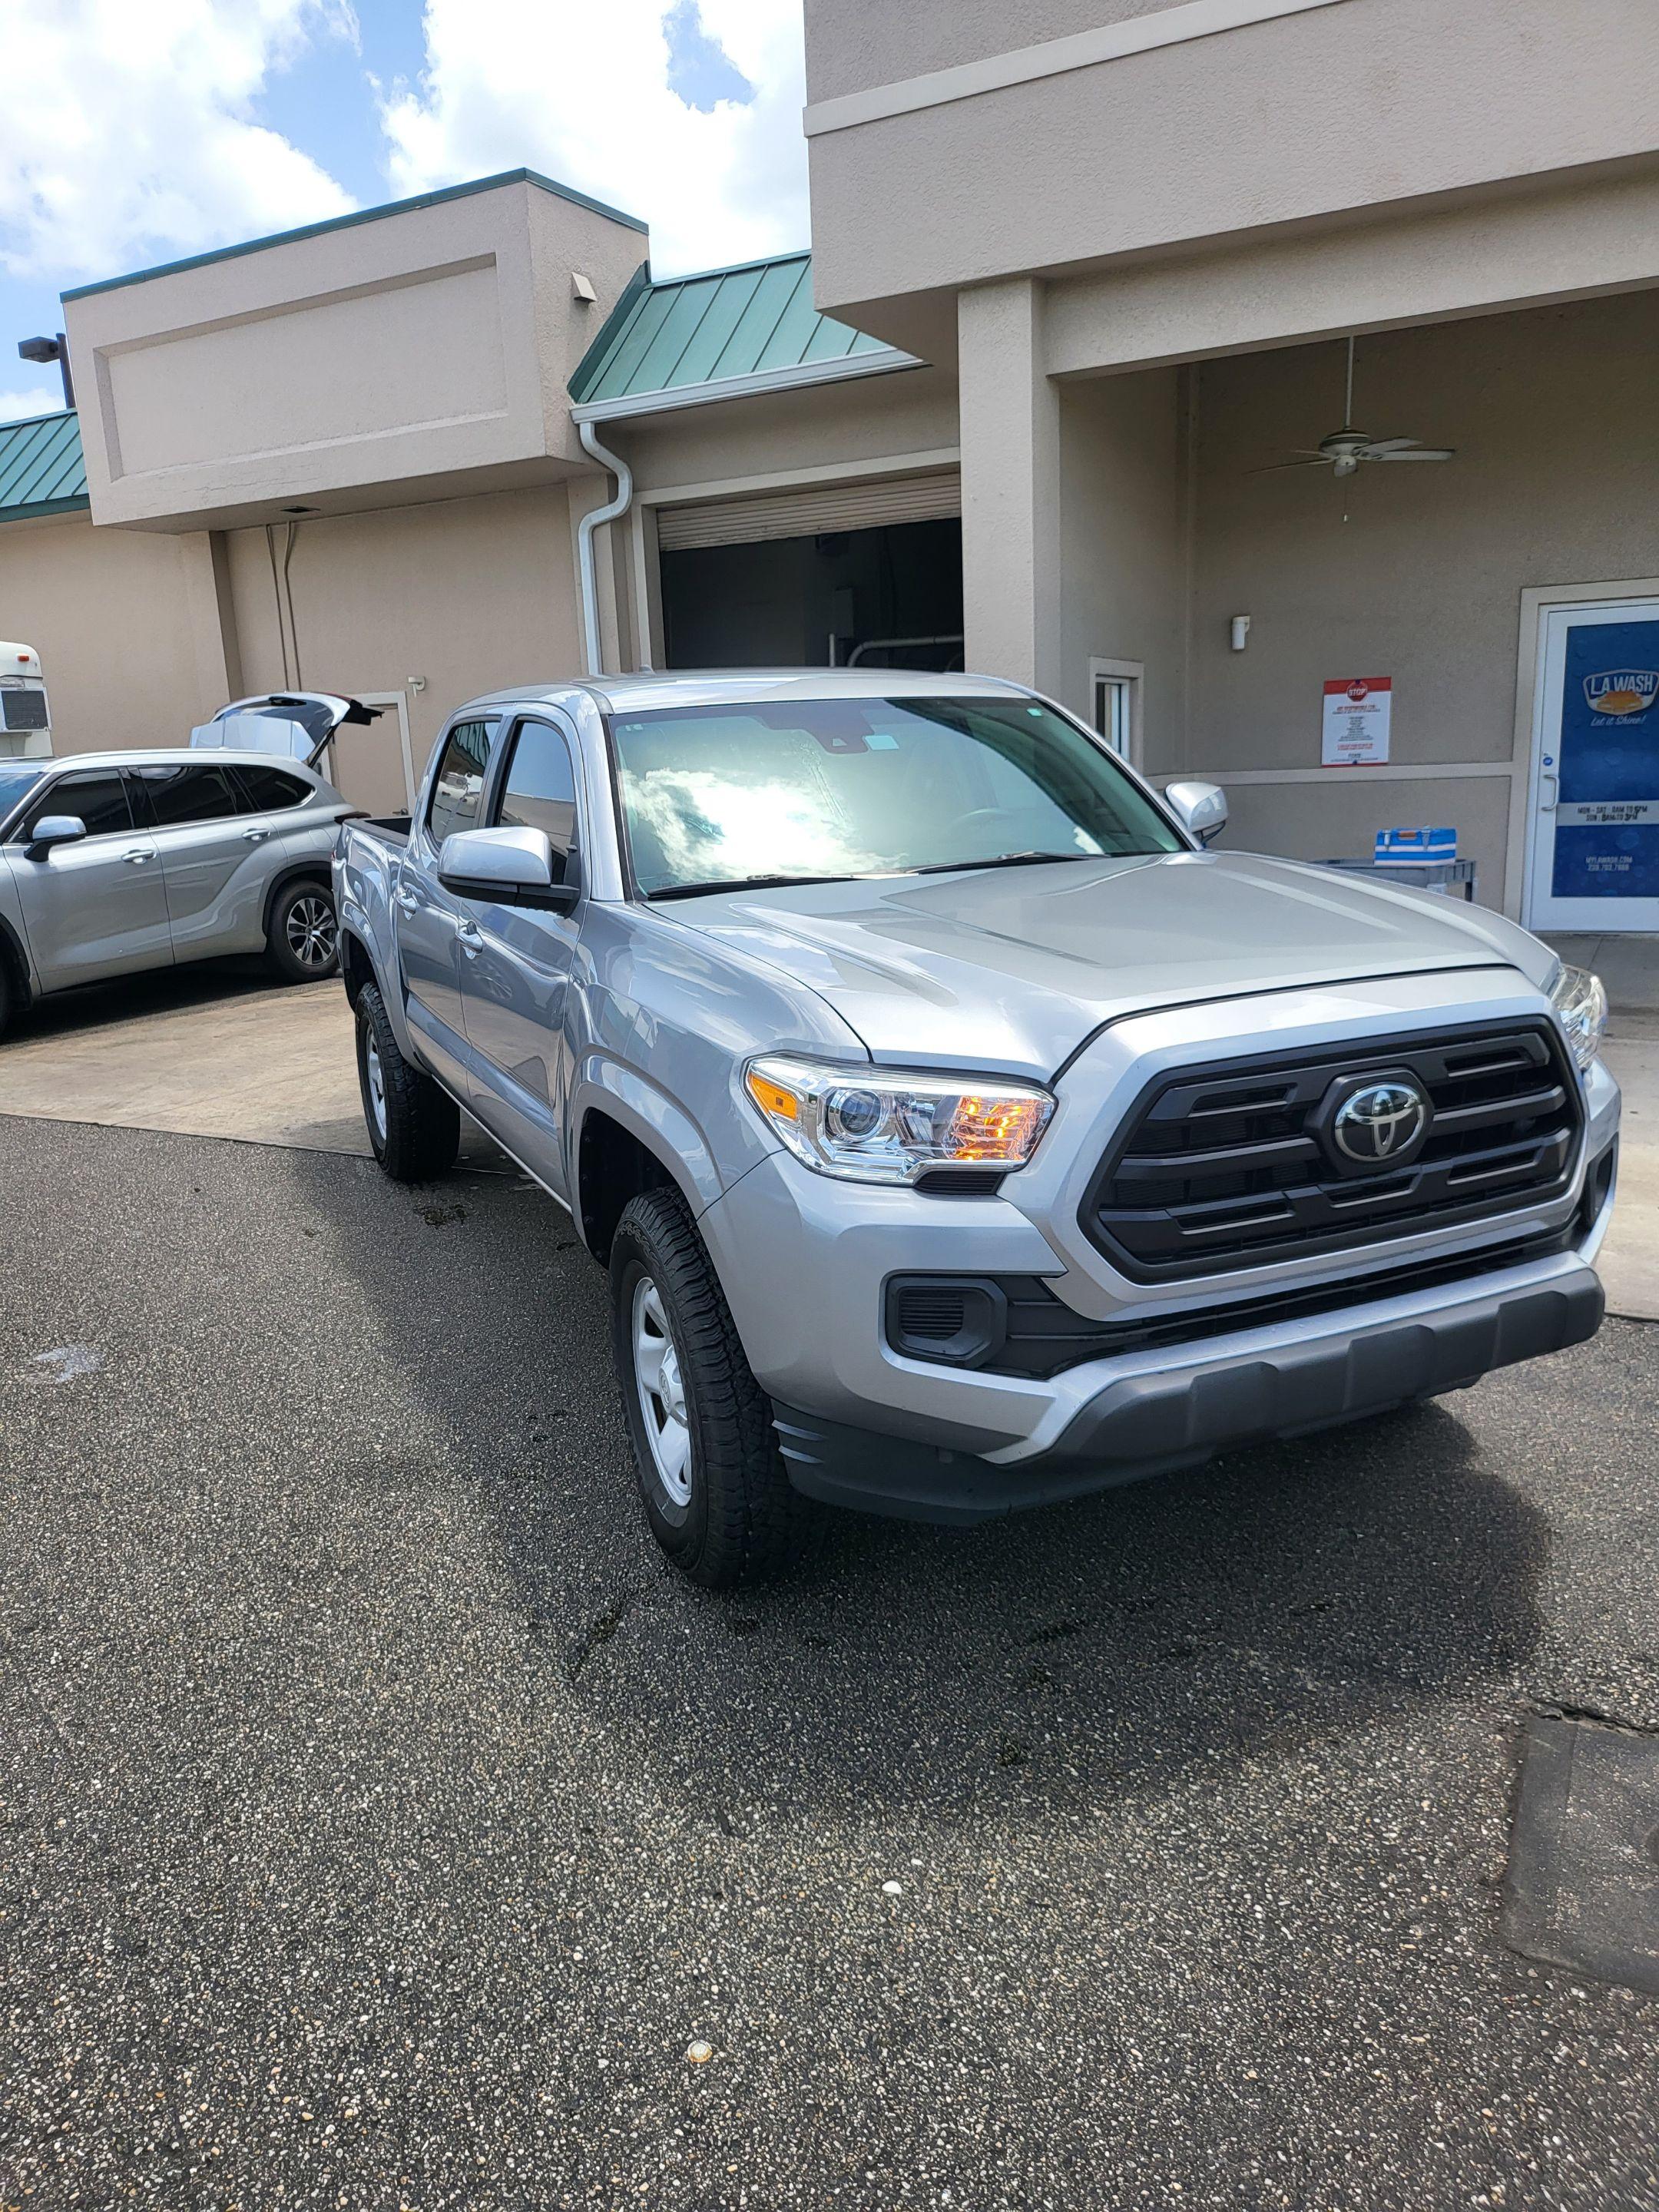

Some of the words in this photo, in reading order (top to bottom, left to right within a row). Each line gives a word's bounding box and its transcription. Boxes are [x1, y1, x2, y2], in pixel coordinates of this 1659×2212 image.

[1591, 677, 1611, 695] LA
[1614, 674, 1654, 692] WASH
[1348, 688, 1367, 697] STOP
